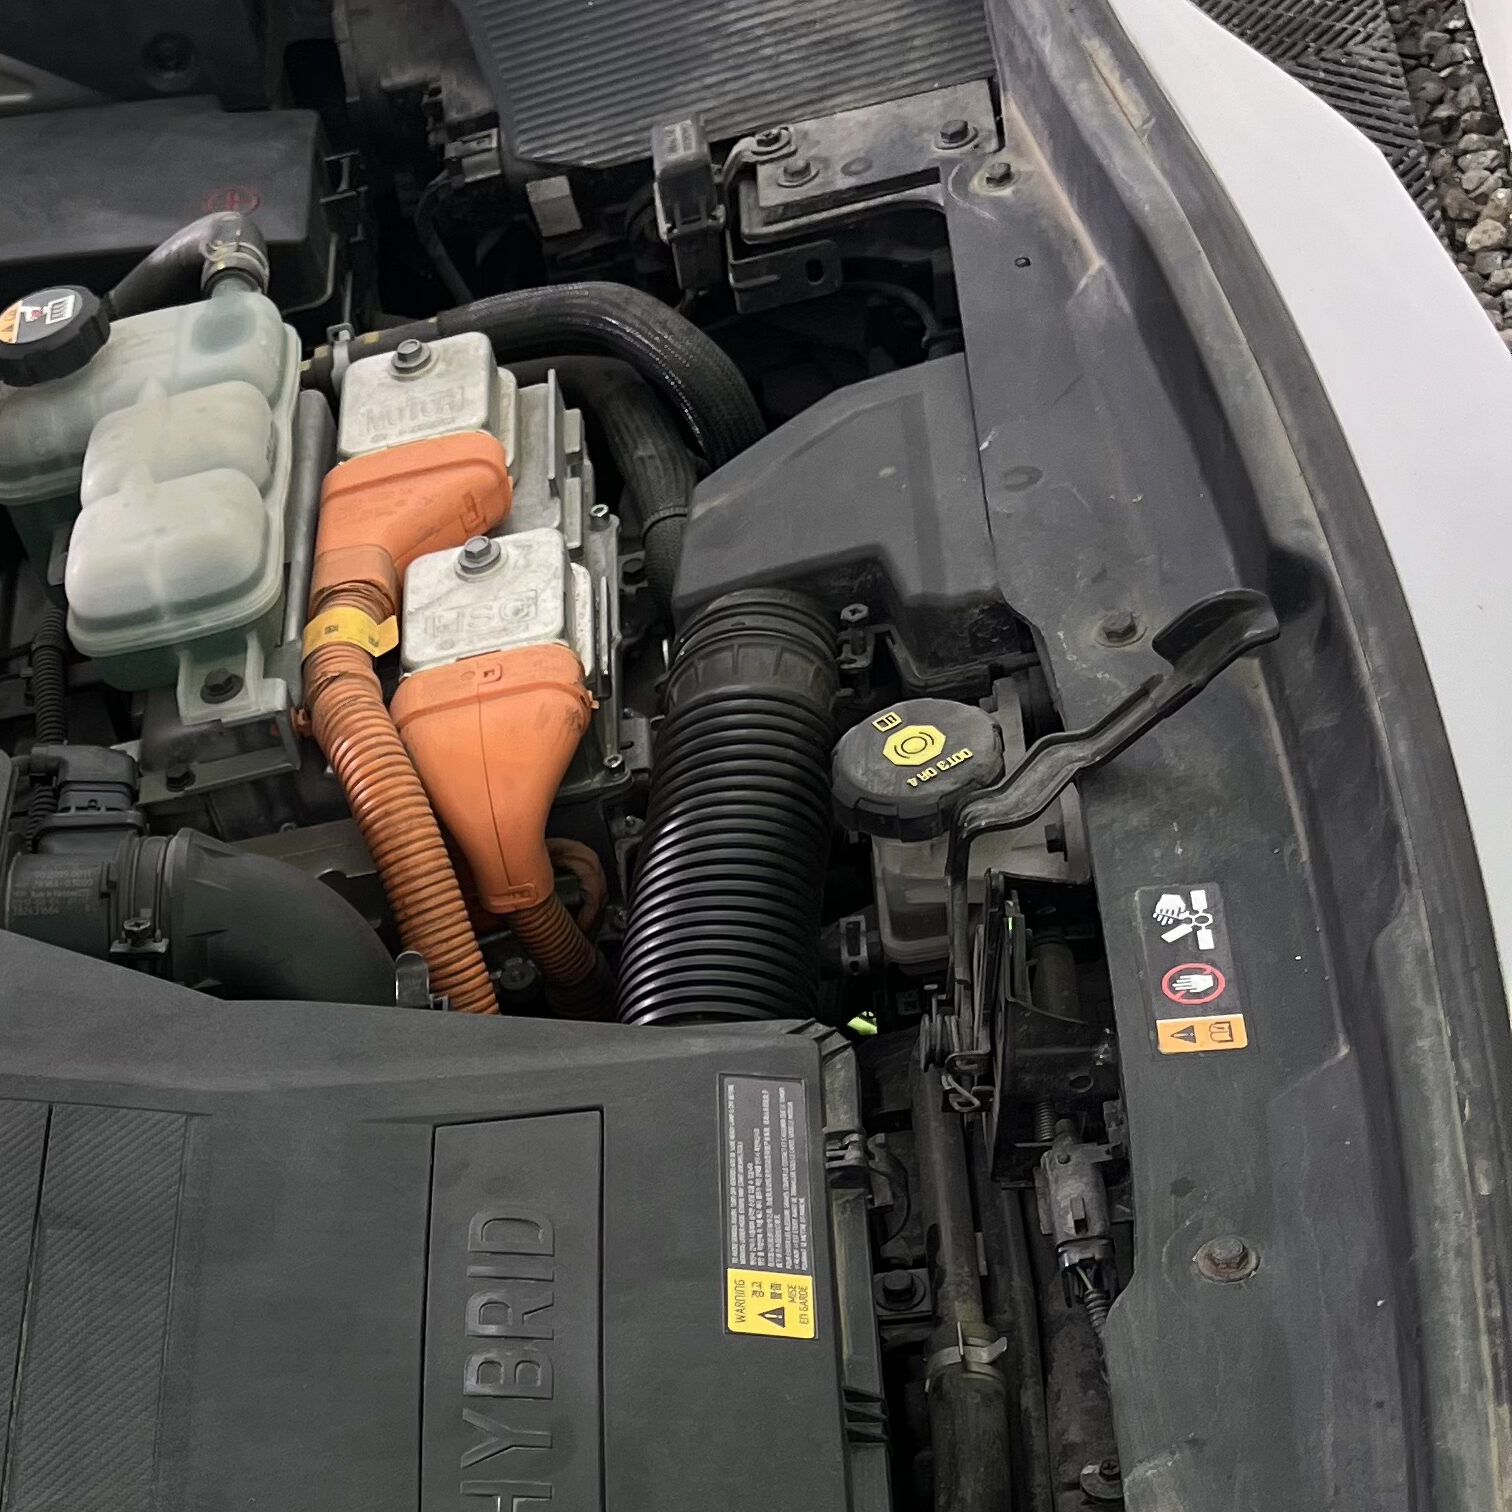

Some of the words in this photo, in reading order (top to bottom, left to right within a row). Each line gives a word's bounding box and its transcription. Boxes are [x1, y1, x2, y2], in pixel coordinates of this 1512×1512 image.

[938, 749, 974, 771] DOT3
[917, 767, 937, 783] OR
[734, 1279, 746, 1323] WARNING
[787, 1284, 797, 1303] MISE
[798, 1285, 808, 1312] GARDE
